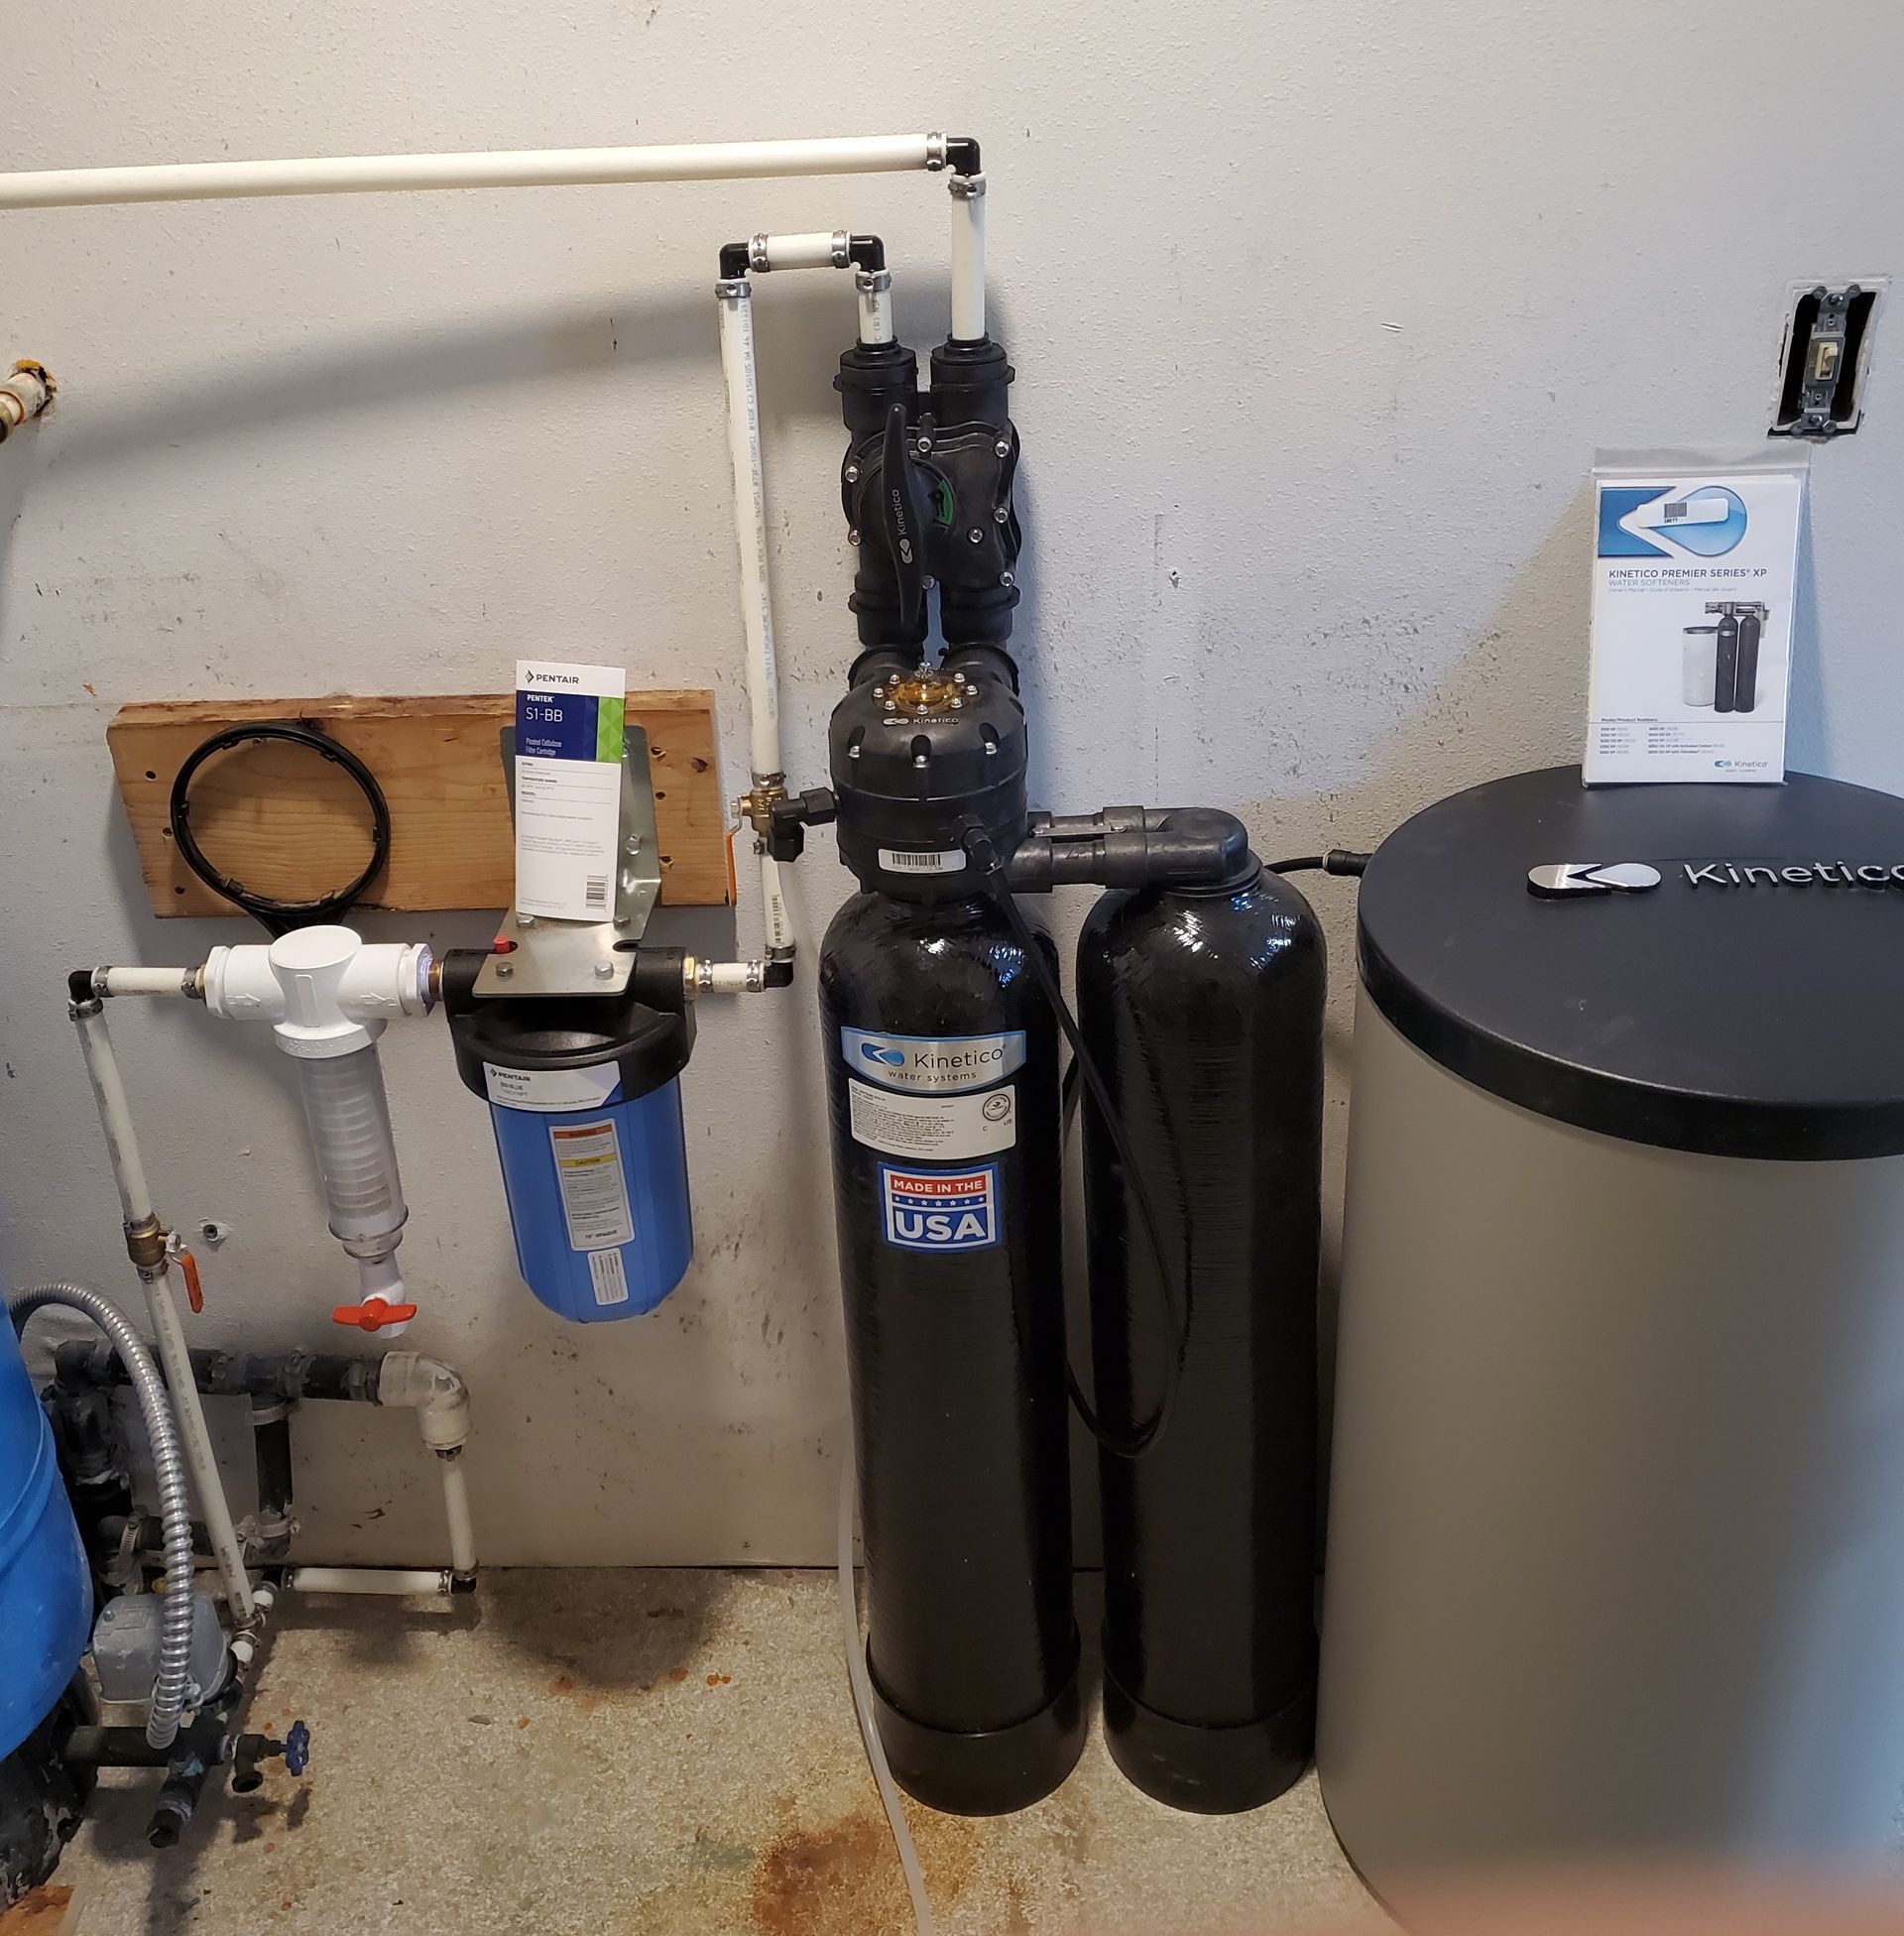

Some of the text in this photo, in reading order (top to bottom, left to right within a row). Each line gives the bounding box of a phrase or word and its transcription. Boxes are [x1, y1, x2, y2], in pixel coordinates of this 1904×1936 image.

[892, 489, 906, 536] Kinetico
[1608, 569, 1659, 578] KINETICO
[1661, 569, 1708, 578] PREMIER
[1753, 568, 1767, 577] XP
[1640, 578, 1691, 587] SOFTENERS
[536, 673, 579, 684] PENTAIR
[526, 706, 563, 723] S1-BB
[498, 1071, 531, 1081] PENTAIR
[888, 1070, 978, 1083] water systems
[893, 1179, 983, 1193] MADE IN THE
[894, 1211, 986, 1242] USA
